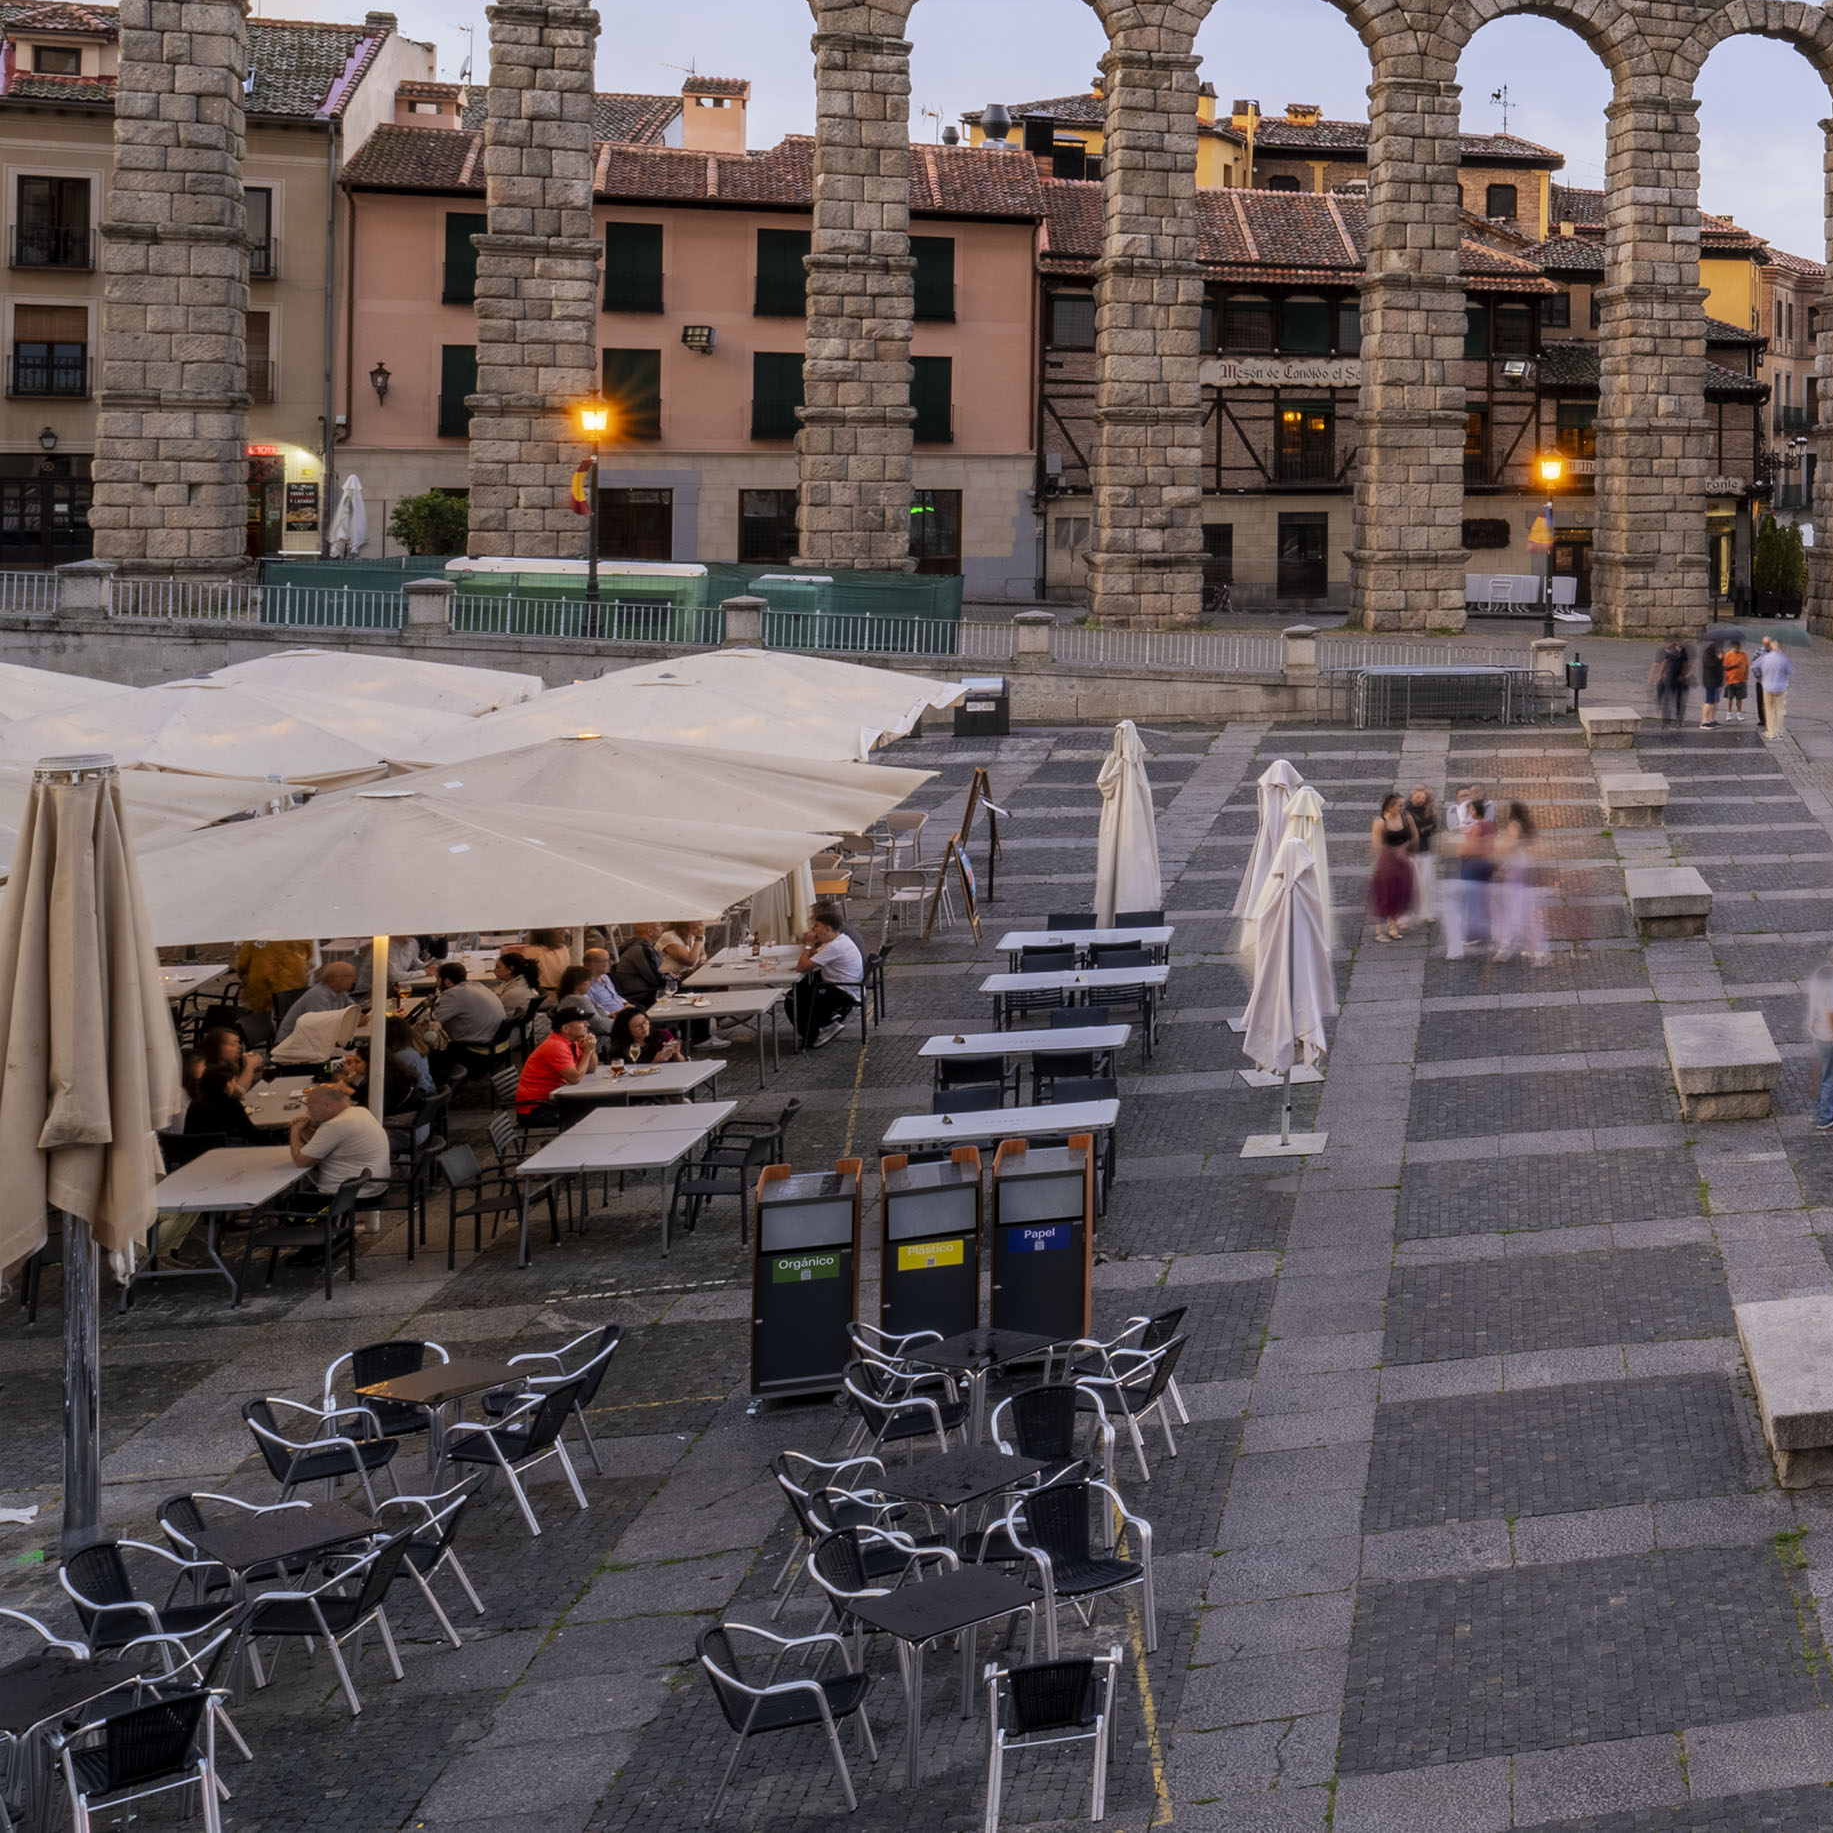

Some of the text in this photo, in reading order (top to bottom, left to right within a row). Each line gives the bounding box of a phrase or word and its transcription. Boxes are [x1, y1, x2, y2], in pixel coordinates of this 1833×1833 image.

[1219, 365, 1263, 380] Mesón
[1267, 368, 1279, 378] de
[1333, 369, 1342, 379] el
[1024, 1227, 1056, 1242] Papel
[906, 1243, 954, 1256] Plástico
[778, 1256, 834, 1270] Orgánico
